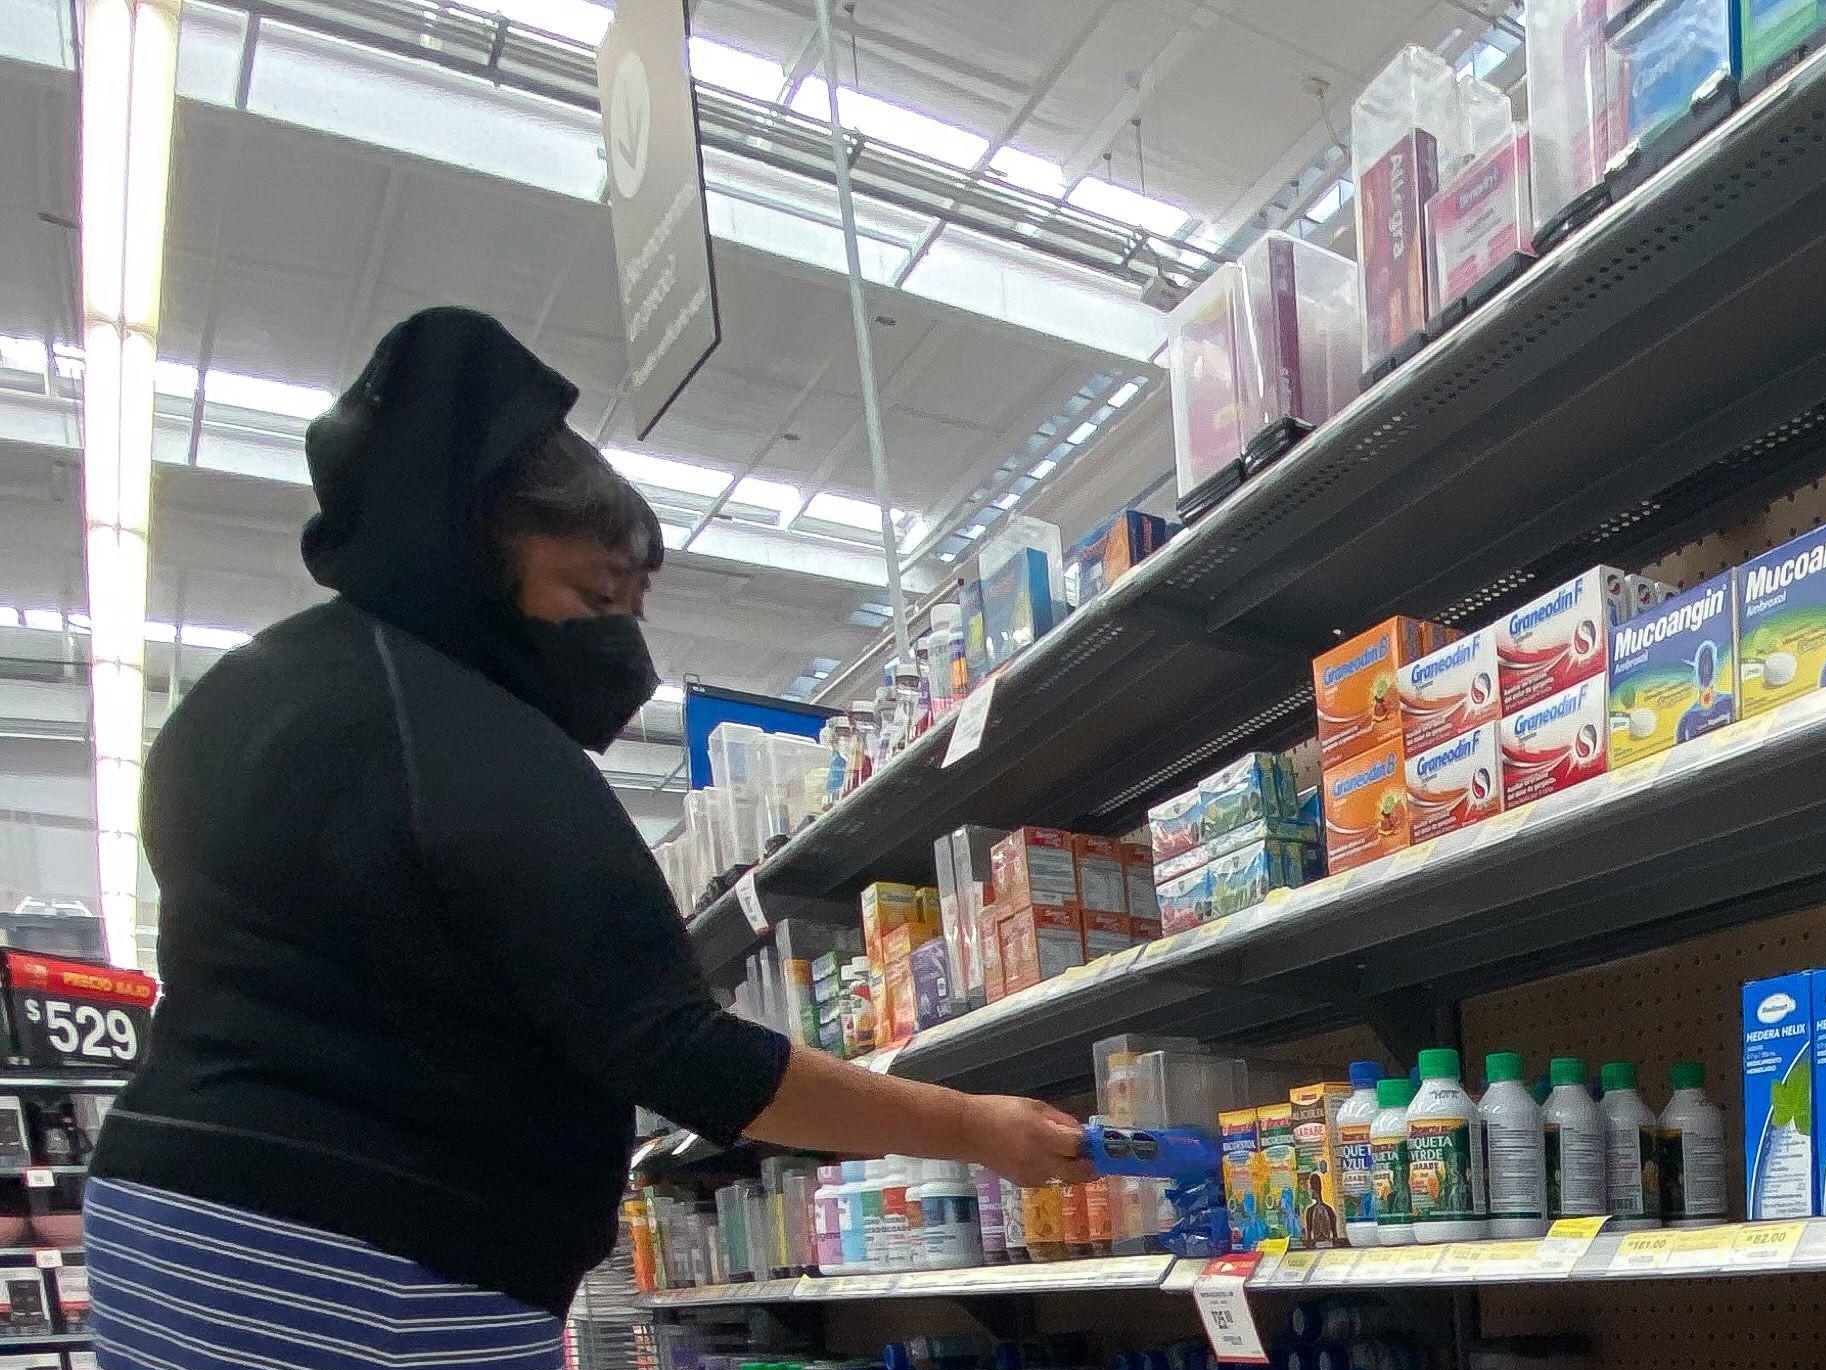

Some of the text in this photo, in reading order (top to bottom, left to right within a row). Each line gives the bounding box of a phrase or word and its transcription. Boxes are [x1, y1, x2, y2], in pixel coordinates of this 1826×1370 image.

[1510, 579, 1583, 636] Graneodin F
[1614, 589, 1724, 661] Mucoangin
[1411, 636, 1480, 684] Graneodin F
[1514, 686, 1589, 736] Graneodin F
[1417, 730, 1480, 776] Graneodin F
[26, 998, 138, 1060] $529
[1746, 1023, 1805, 1042] HEDERA HELIX
